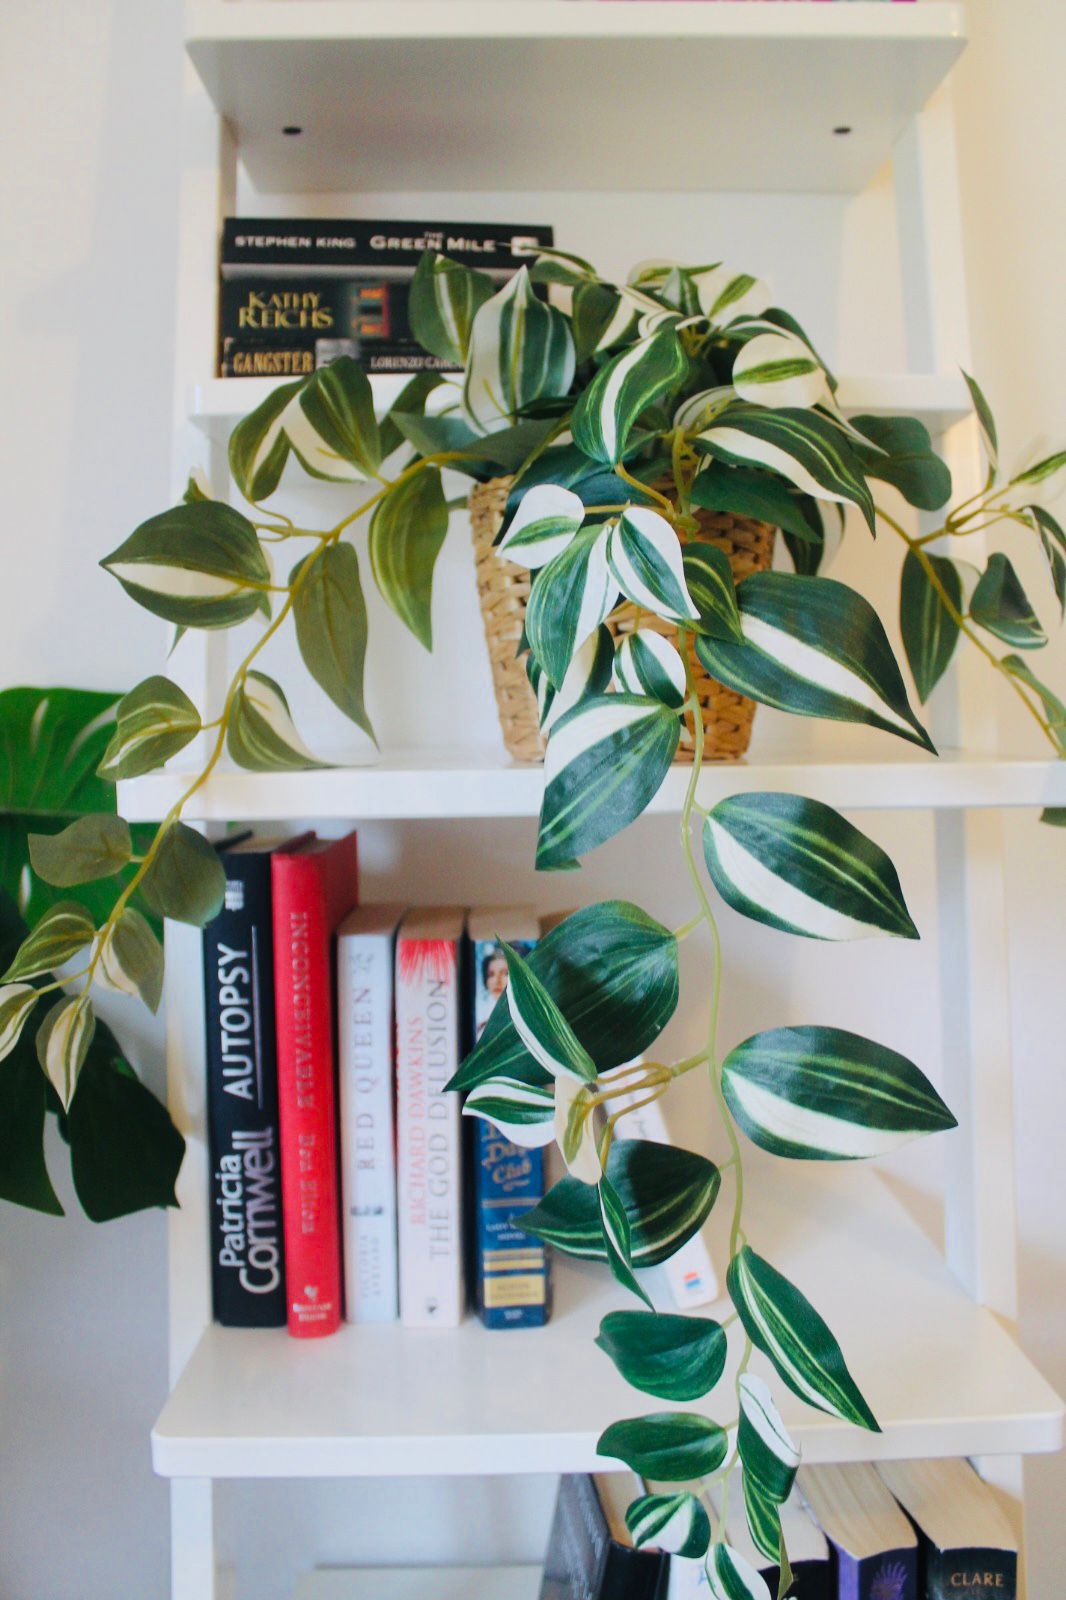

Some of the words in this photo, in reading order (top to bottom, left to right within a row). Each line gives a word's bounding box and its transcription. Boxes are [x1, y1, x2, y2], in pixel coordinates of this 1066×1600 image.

[234, 235, 312, 249] STEPHEN
[315, 236, 357, 249] KING
[239, 306, 334, 329] REICHS
[249, 291, 321, 309] KATHY
[233, 351, 314, 373] GANGSTER
[370, 355, 423, 370] LORENZO
[217, 942, 253, 1100] AUTOPSY
[290, 911, 314, 1109] INCONCEIVABLE
[354, 986, 378, 1094] QUEEN
[408, 1015, 425, 1119] DAWKINS
[427, 978, 448, 1121] DELUSION
[356, 1112, 375, 1170] RED
[428, 1132, 449, 1198] GOD
[409, 1125, 426, 1225] RICHARD
[215, 1153, 245, 1267] Patricia
[231, 1127, 280, 1294] Cornwell
[429, 1209, 450, 1262] THE
[950, 1571, 1005, 1588] CLARE
